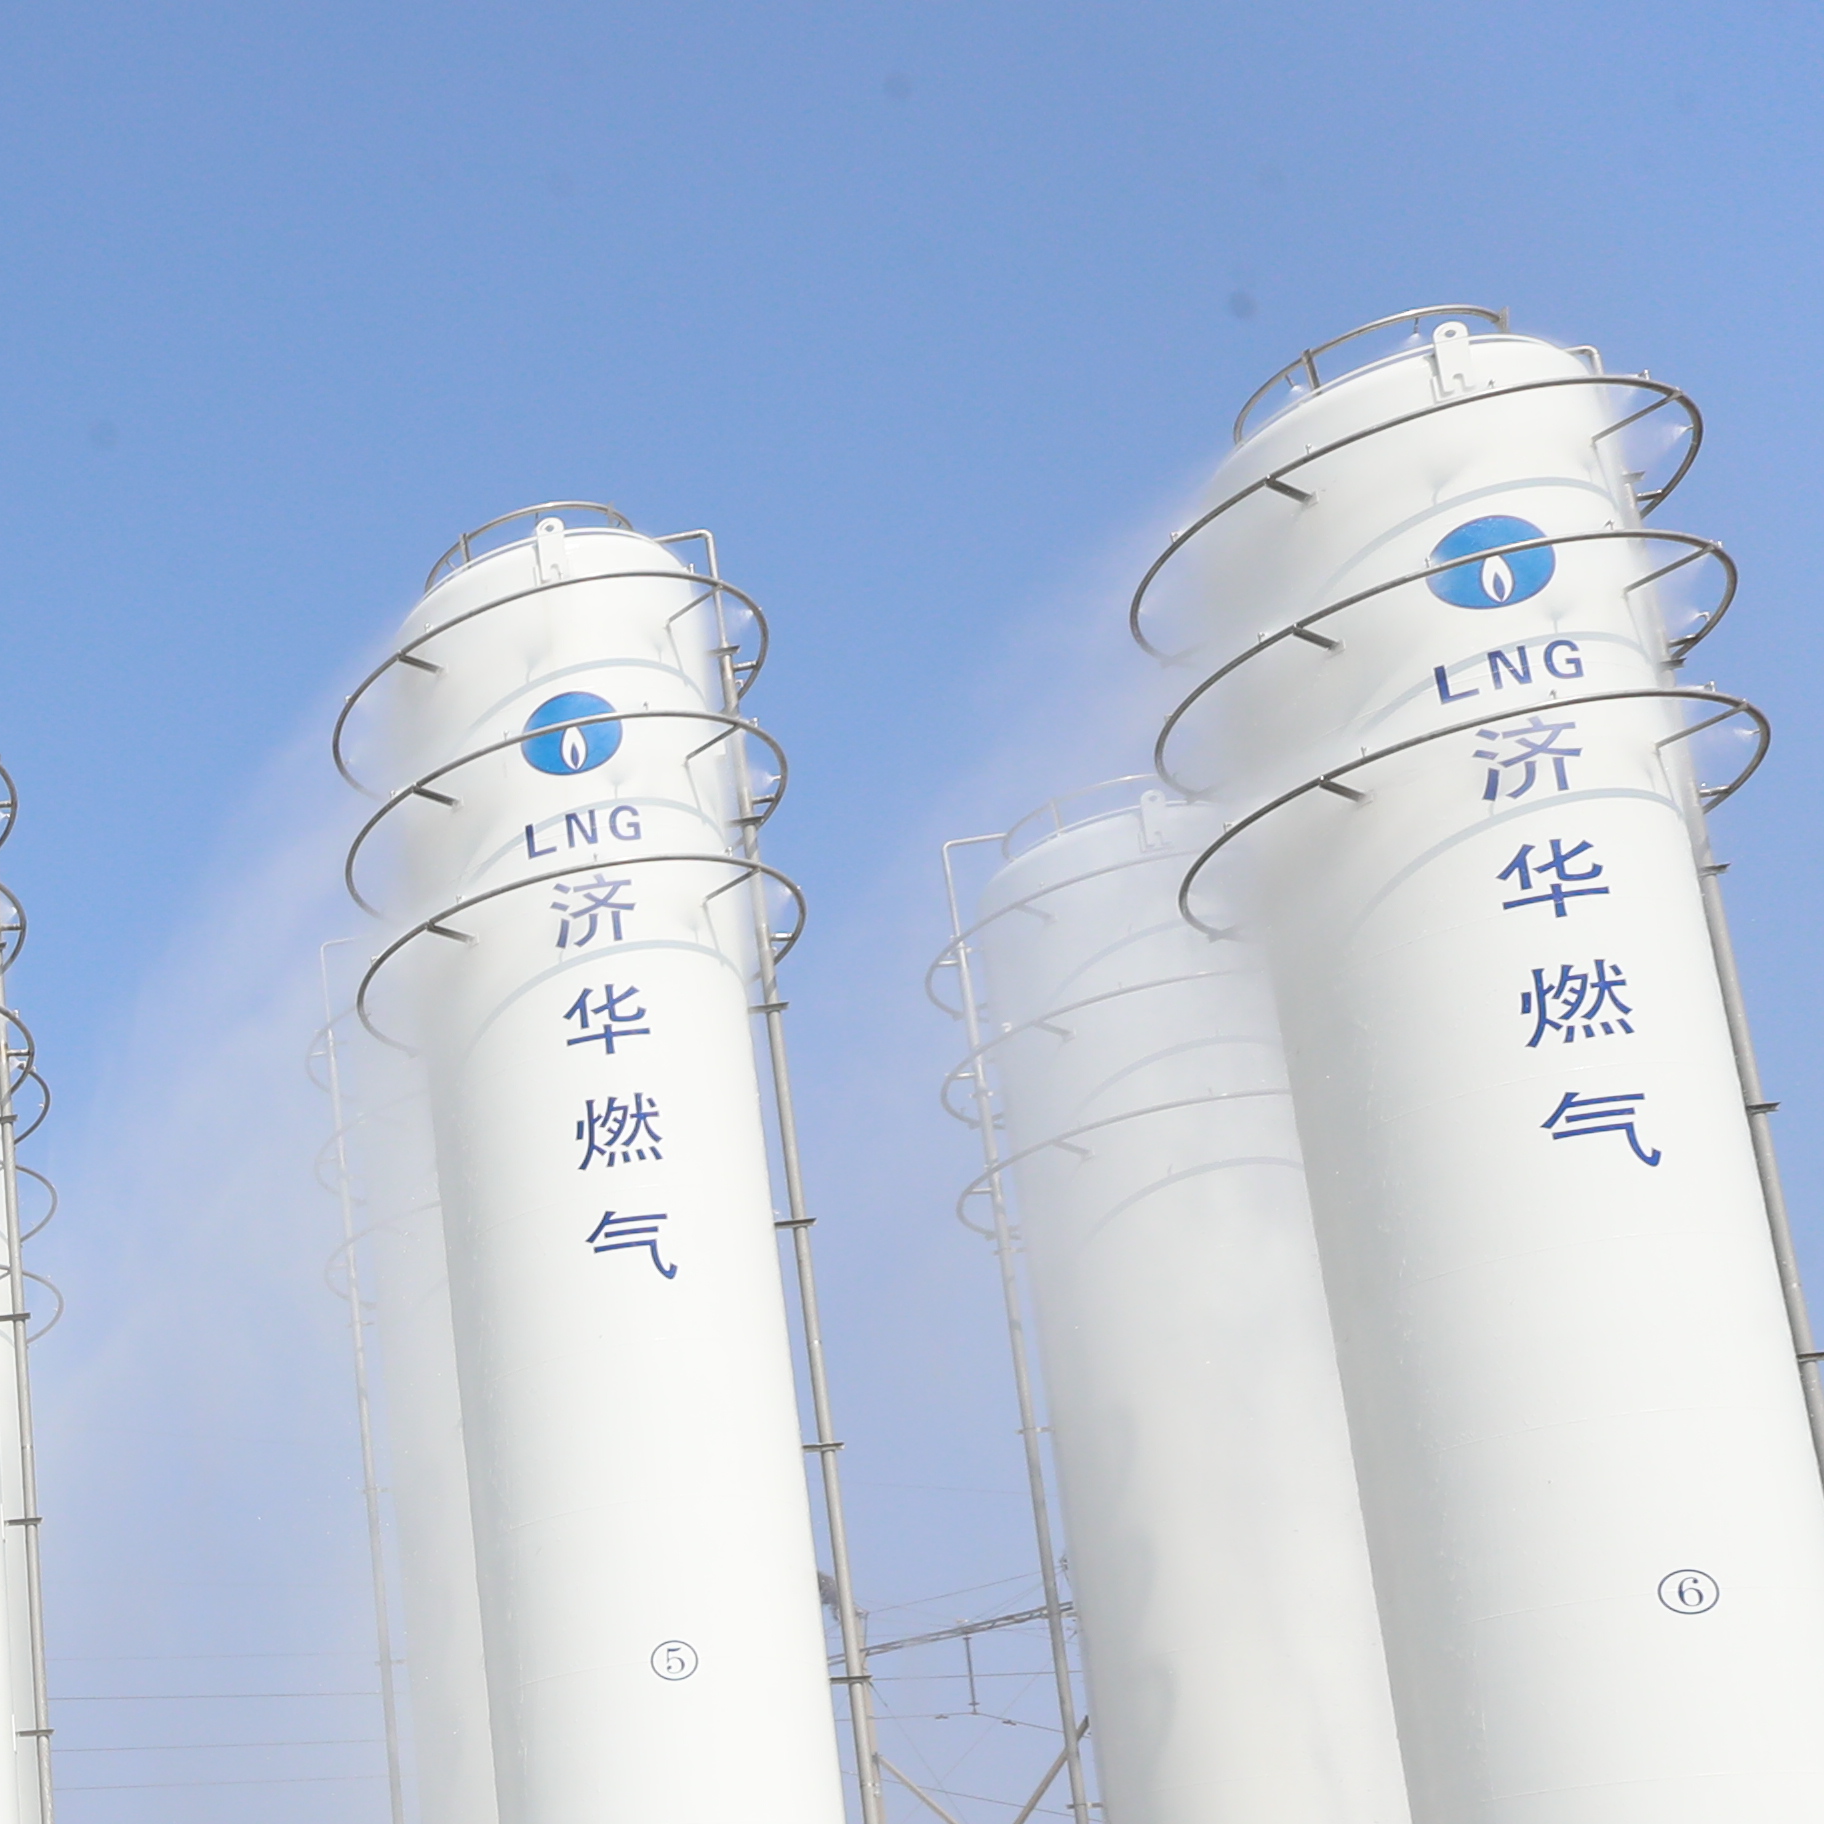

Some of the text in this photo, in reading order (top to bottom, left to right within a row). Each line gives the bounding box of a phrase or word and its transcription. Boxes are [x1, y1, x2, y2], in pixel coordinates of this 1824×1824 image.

[1435, 639, 1585, 705] LNG
[525, 804, 642, 859] LNG
[1472, 715, 1662, 1168] 济华燃气
[549, 873, 679, 1281] 济华燃气
